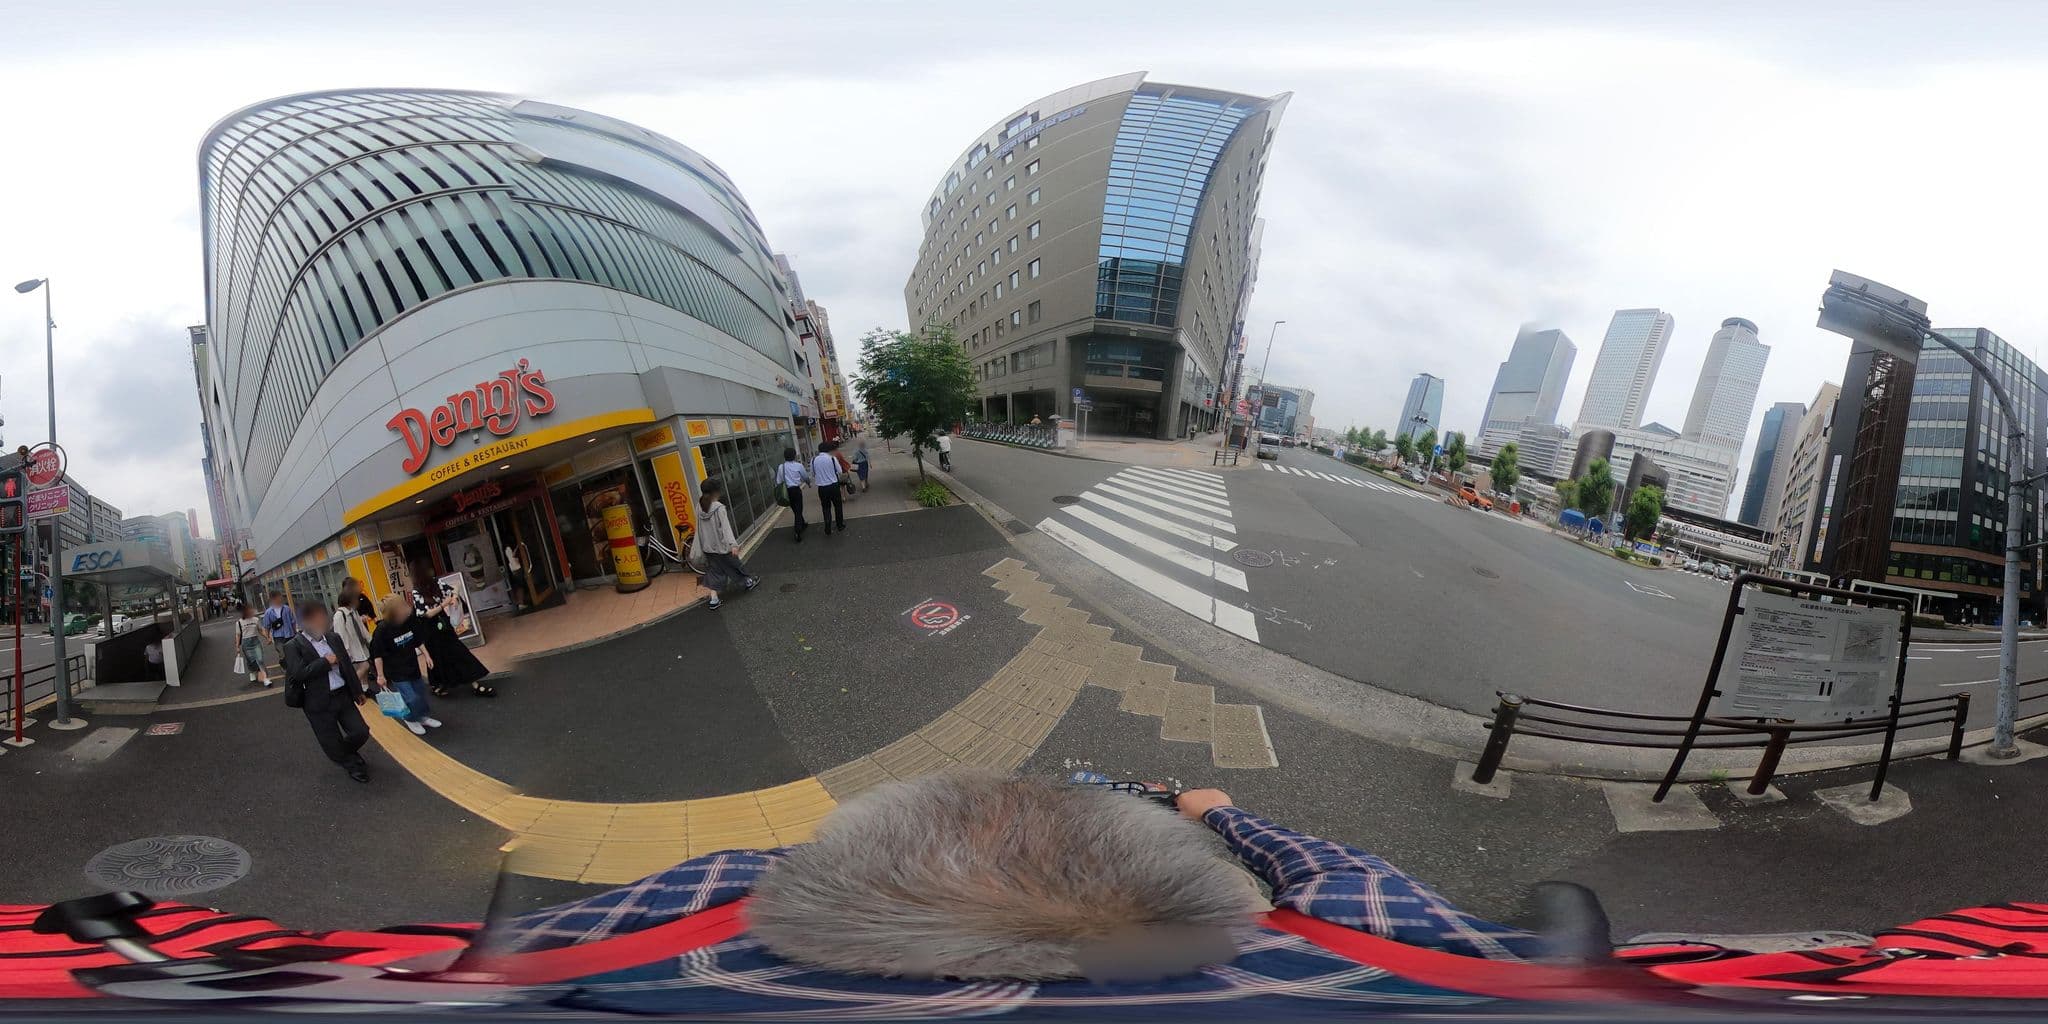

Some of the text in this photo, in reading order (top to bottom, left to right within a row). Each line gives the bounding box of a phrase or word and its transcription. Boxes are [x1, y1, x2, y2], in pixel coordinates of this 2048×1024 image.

[386, 358, 556, 474] Denny's
[29, 458, 57, 477] 消火栓
[430, 462, 461, 482] COFFEE
[464, 458, 471, 467] &
[28, 490, 67, 504] だまりこころ
[29, 500, 59, 512] クリニック
[72, 549, 124, 572] ESCA
[623, 554, 639, 564] 入口
